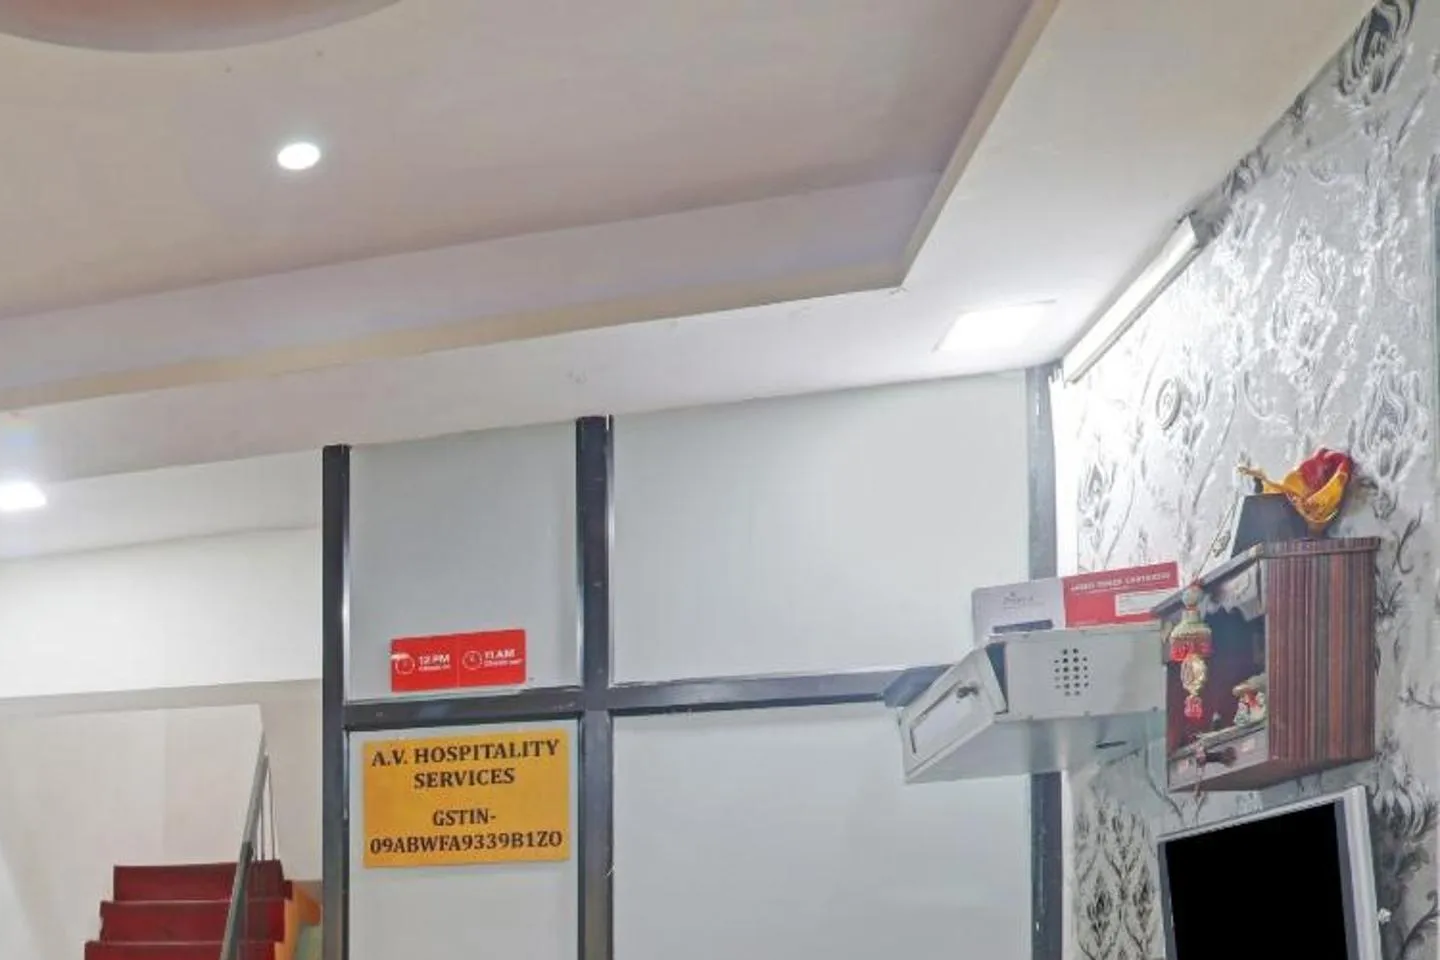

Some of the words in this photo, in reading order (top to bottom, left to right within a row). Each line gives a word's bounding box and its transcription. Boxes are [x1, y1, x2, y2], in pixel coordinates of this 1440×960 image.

[371, 748, 408, 767] A.V.
[414, 739, 560, 764] HOSPITALITY
[414, 767, 516, 790] SERVICES
[432, 808, 497, 827] GSTIN-
